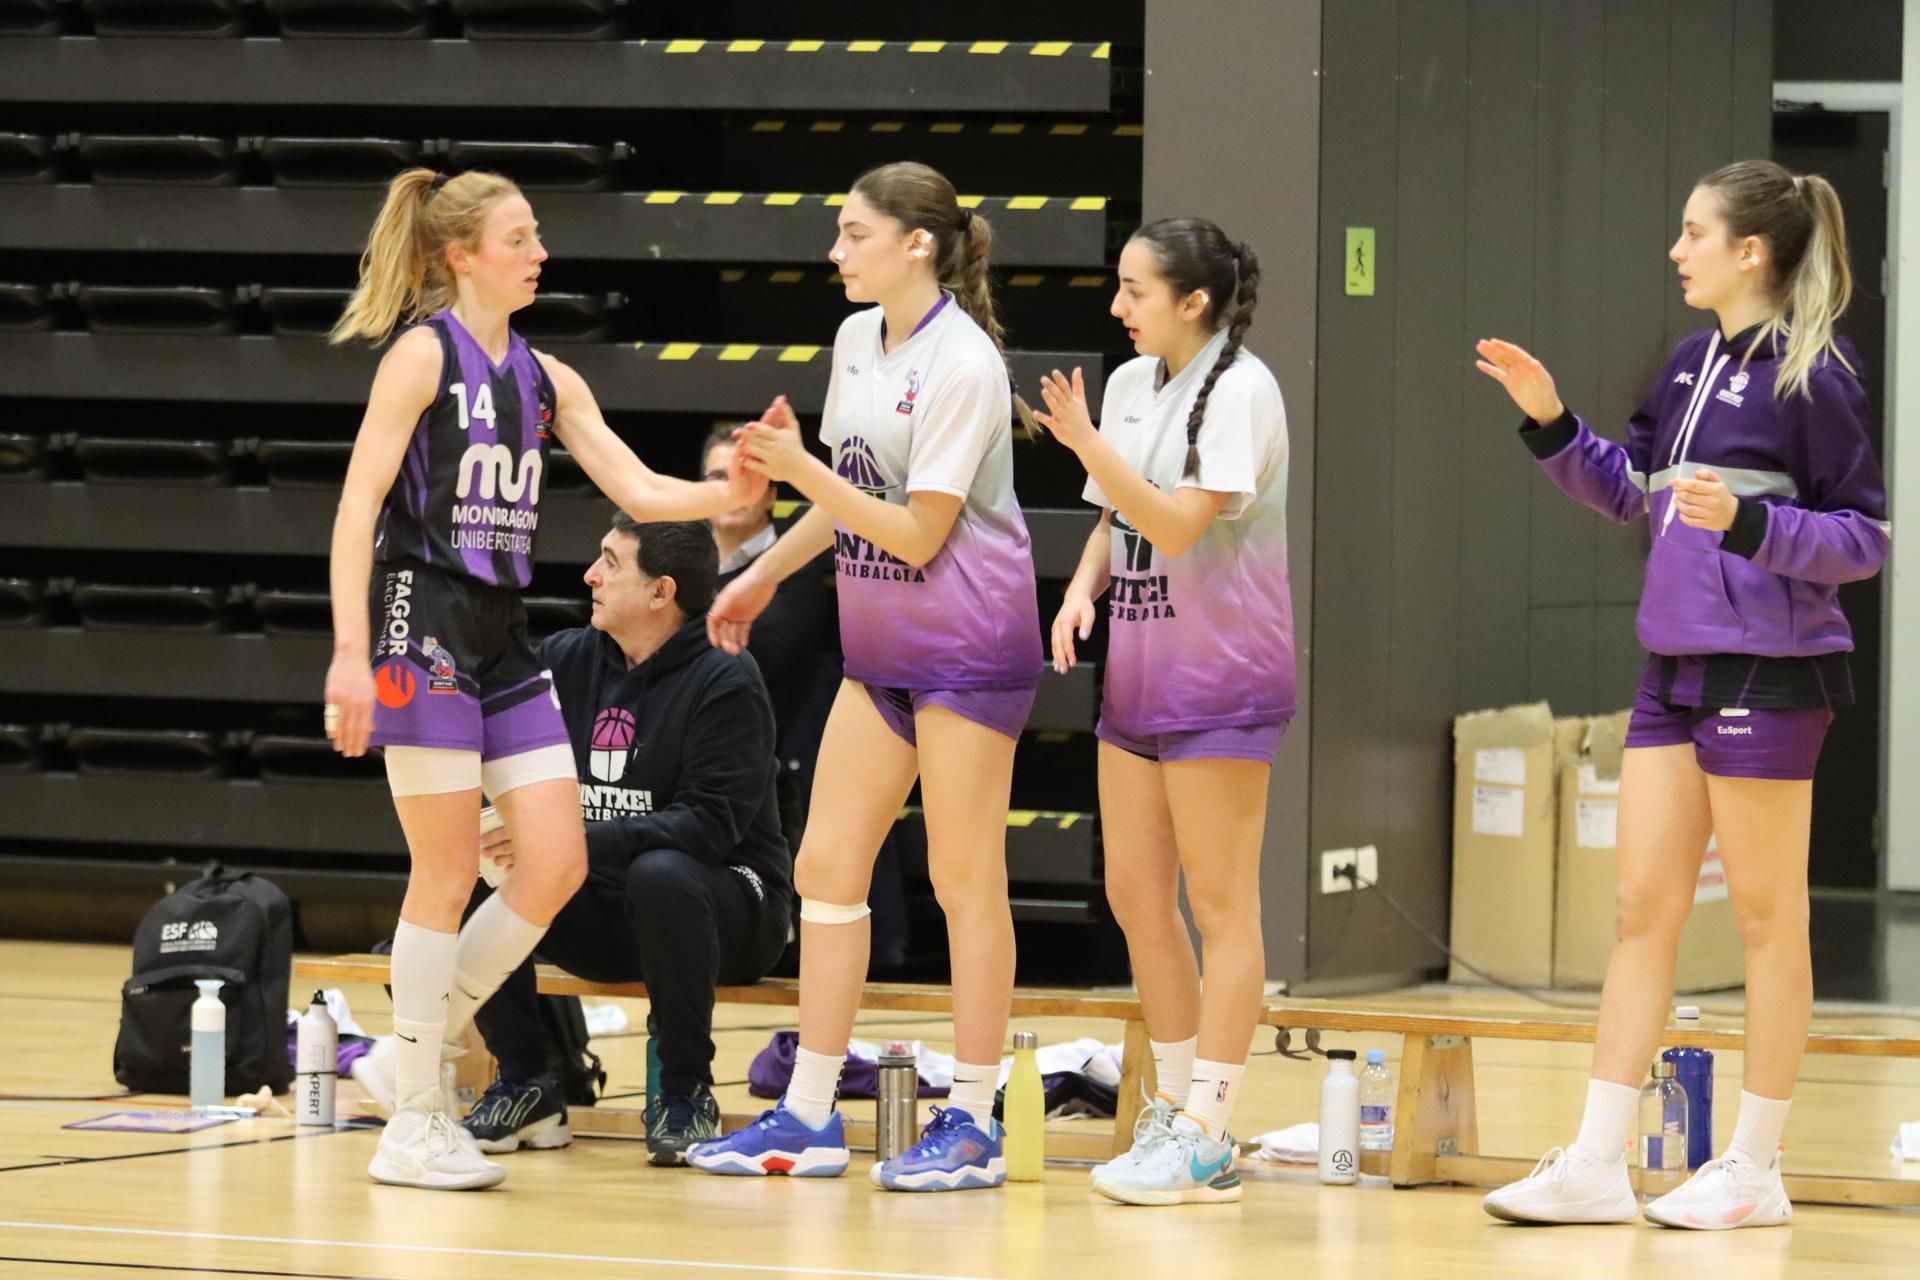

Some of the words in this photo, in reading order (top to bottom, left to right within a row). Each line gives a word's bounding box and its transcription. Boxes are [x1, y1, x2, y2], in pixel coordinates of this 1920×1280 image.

[449, 382, 497, 430] 14
[389, 570, 414, 656] FAGOR
[1717, 726, 1752, 736] EuSport
[162, 921, 189, 941] ESF
